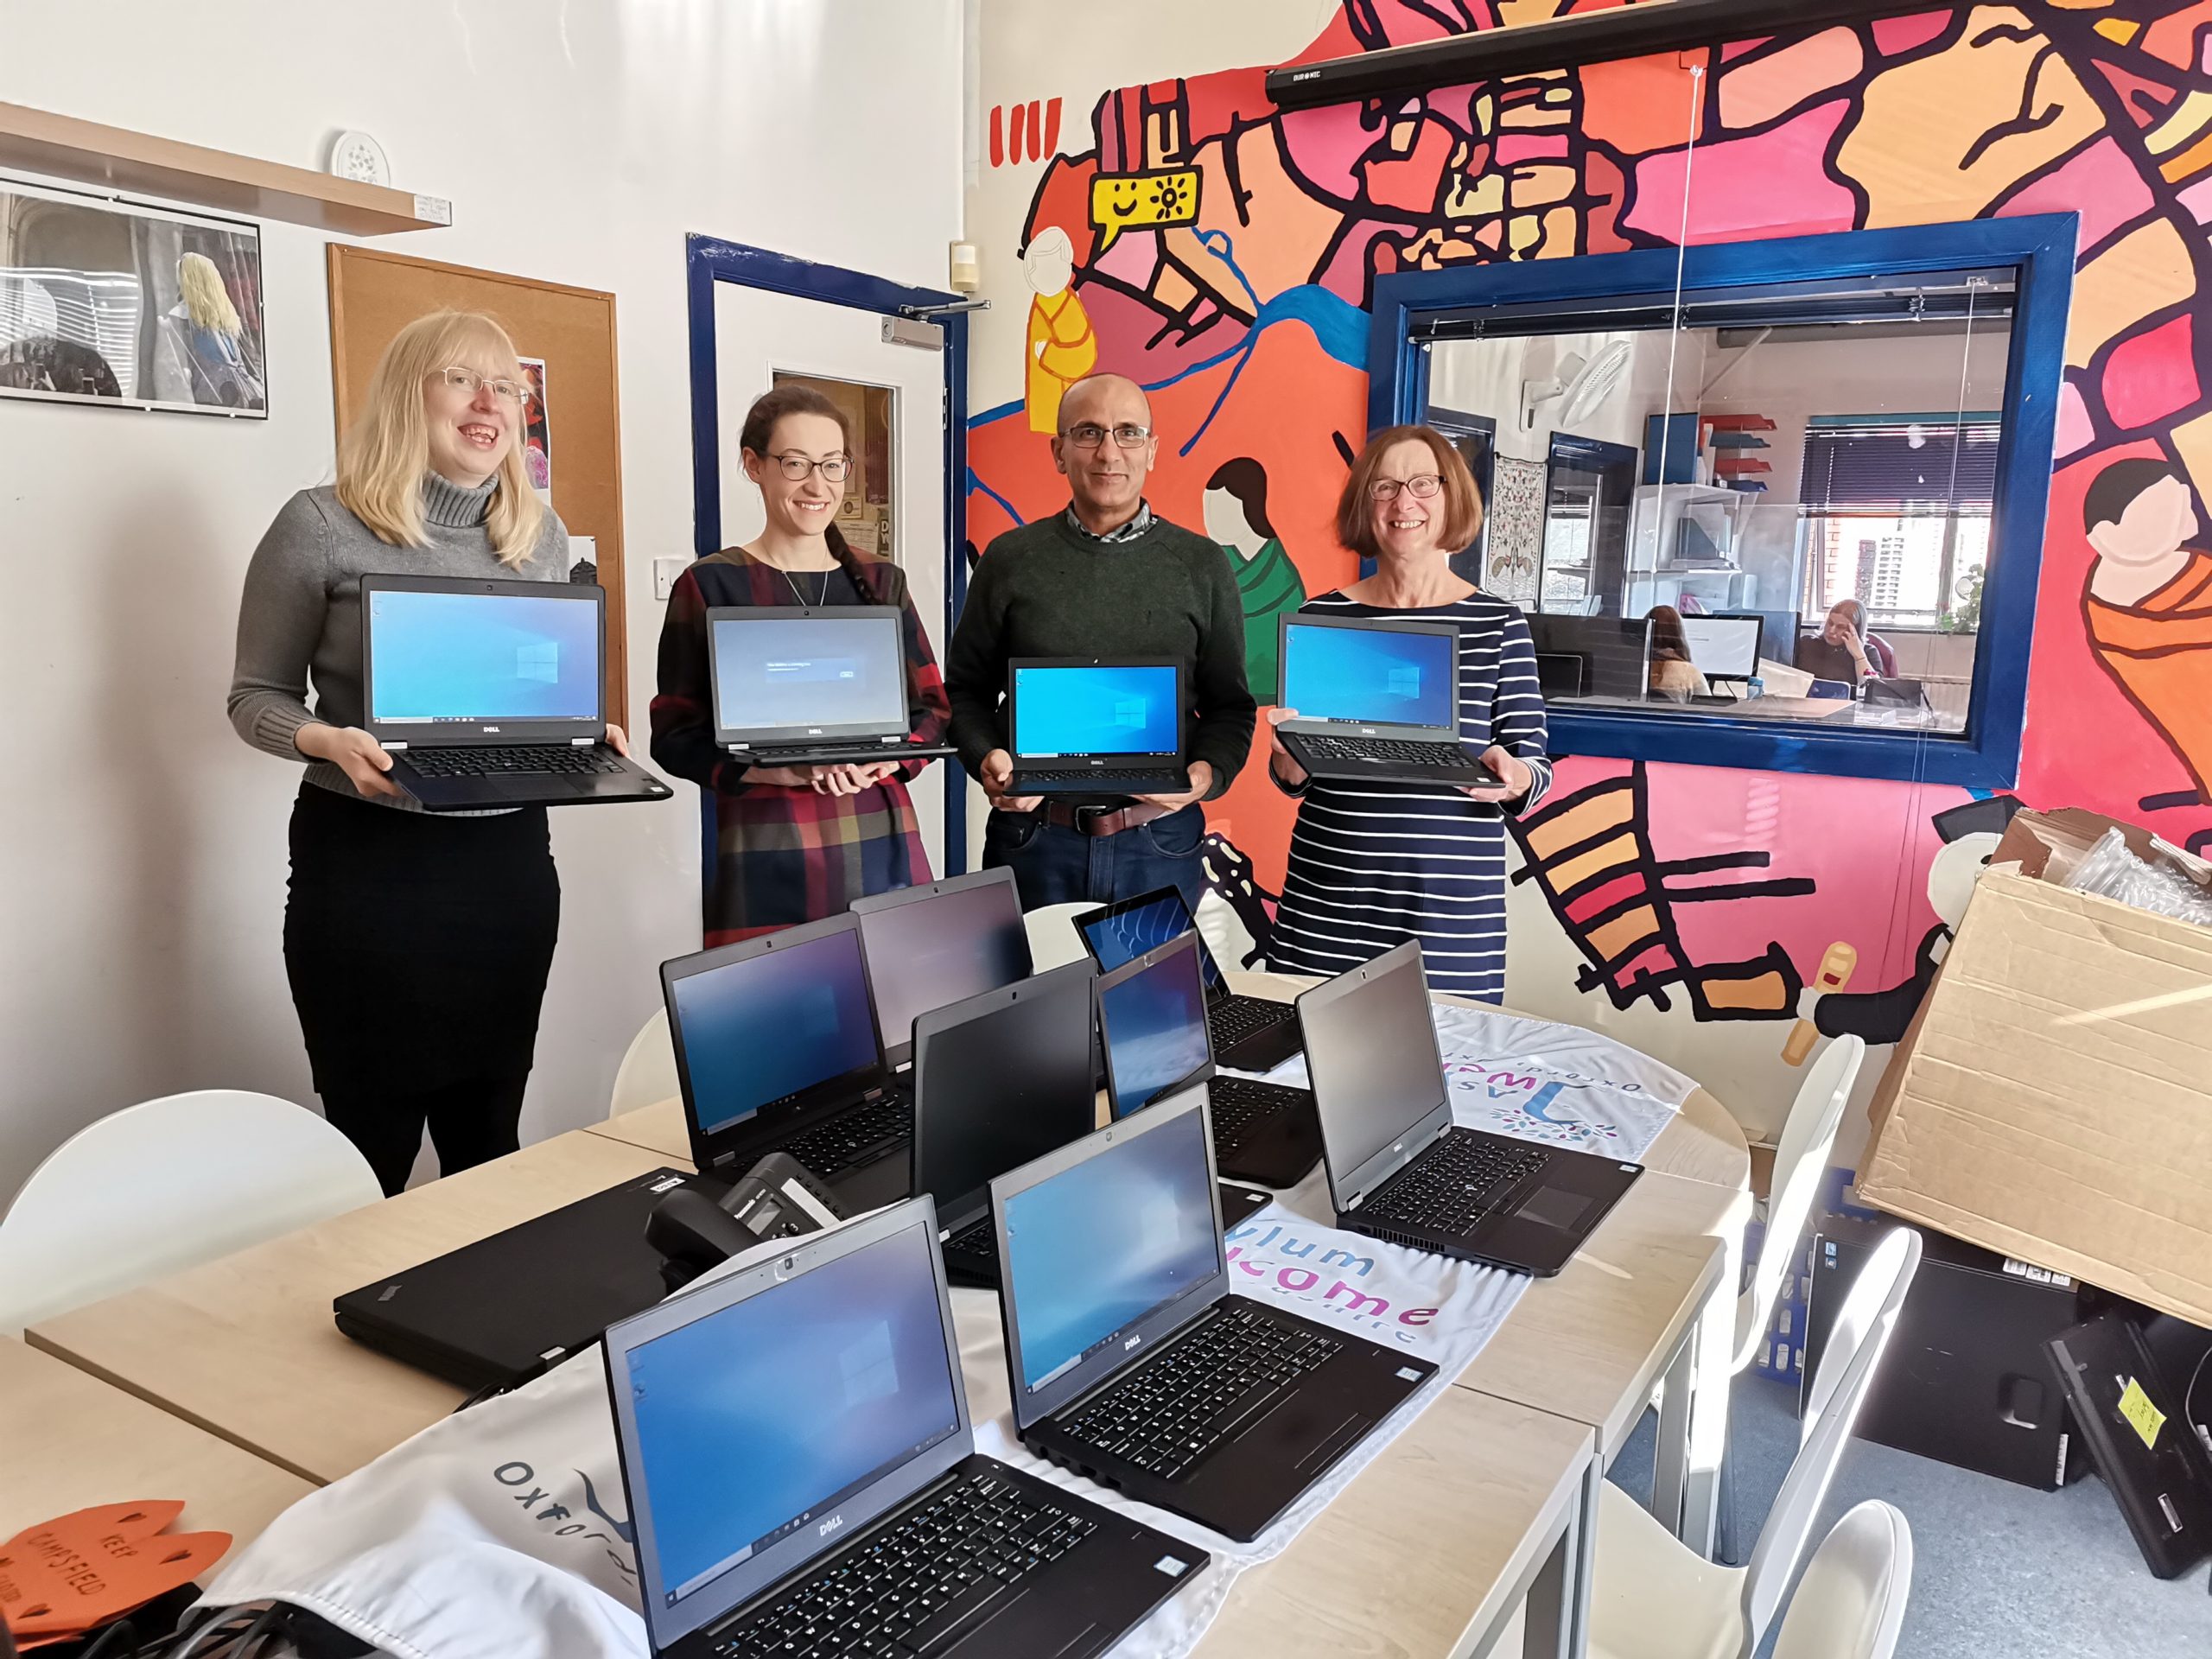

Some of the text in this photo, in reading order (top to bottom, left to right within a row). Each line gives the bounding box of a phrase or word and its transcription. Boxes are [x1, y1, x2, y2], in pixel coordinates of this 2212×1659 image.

[1125, 1334, 1141, 1351] DELL
[819, 1515, 843, 1536] DELL
[99, 1534, 138, 1560] KEEP
